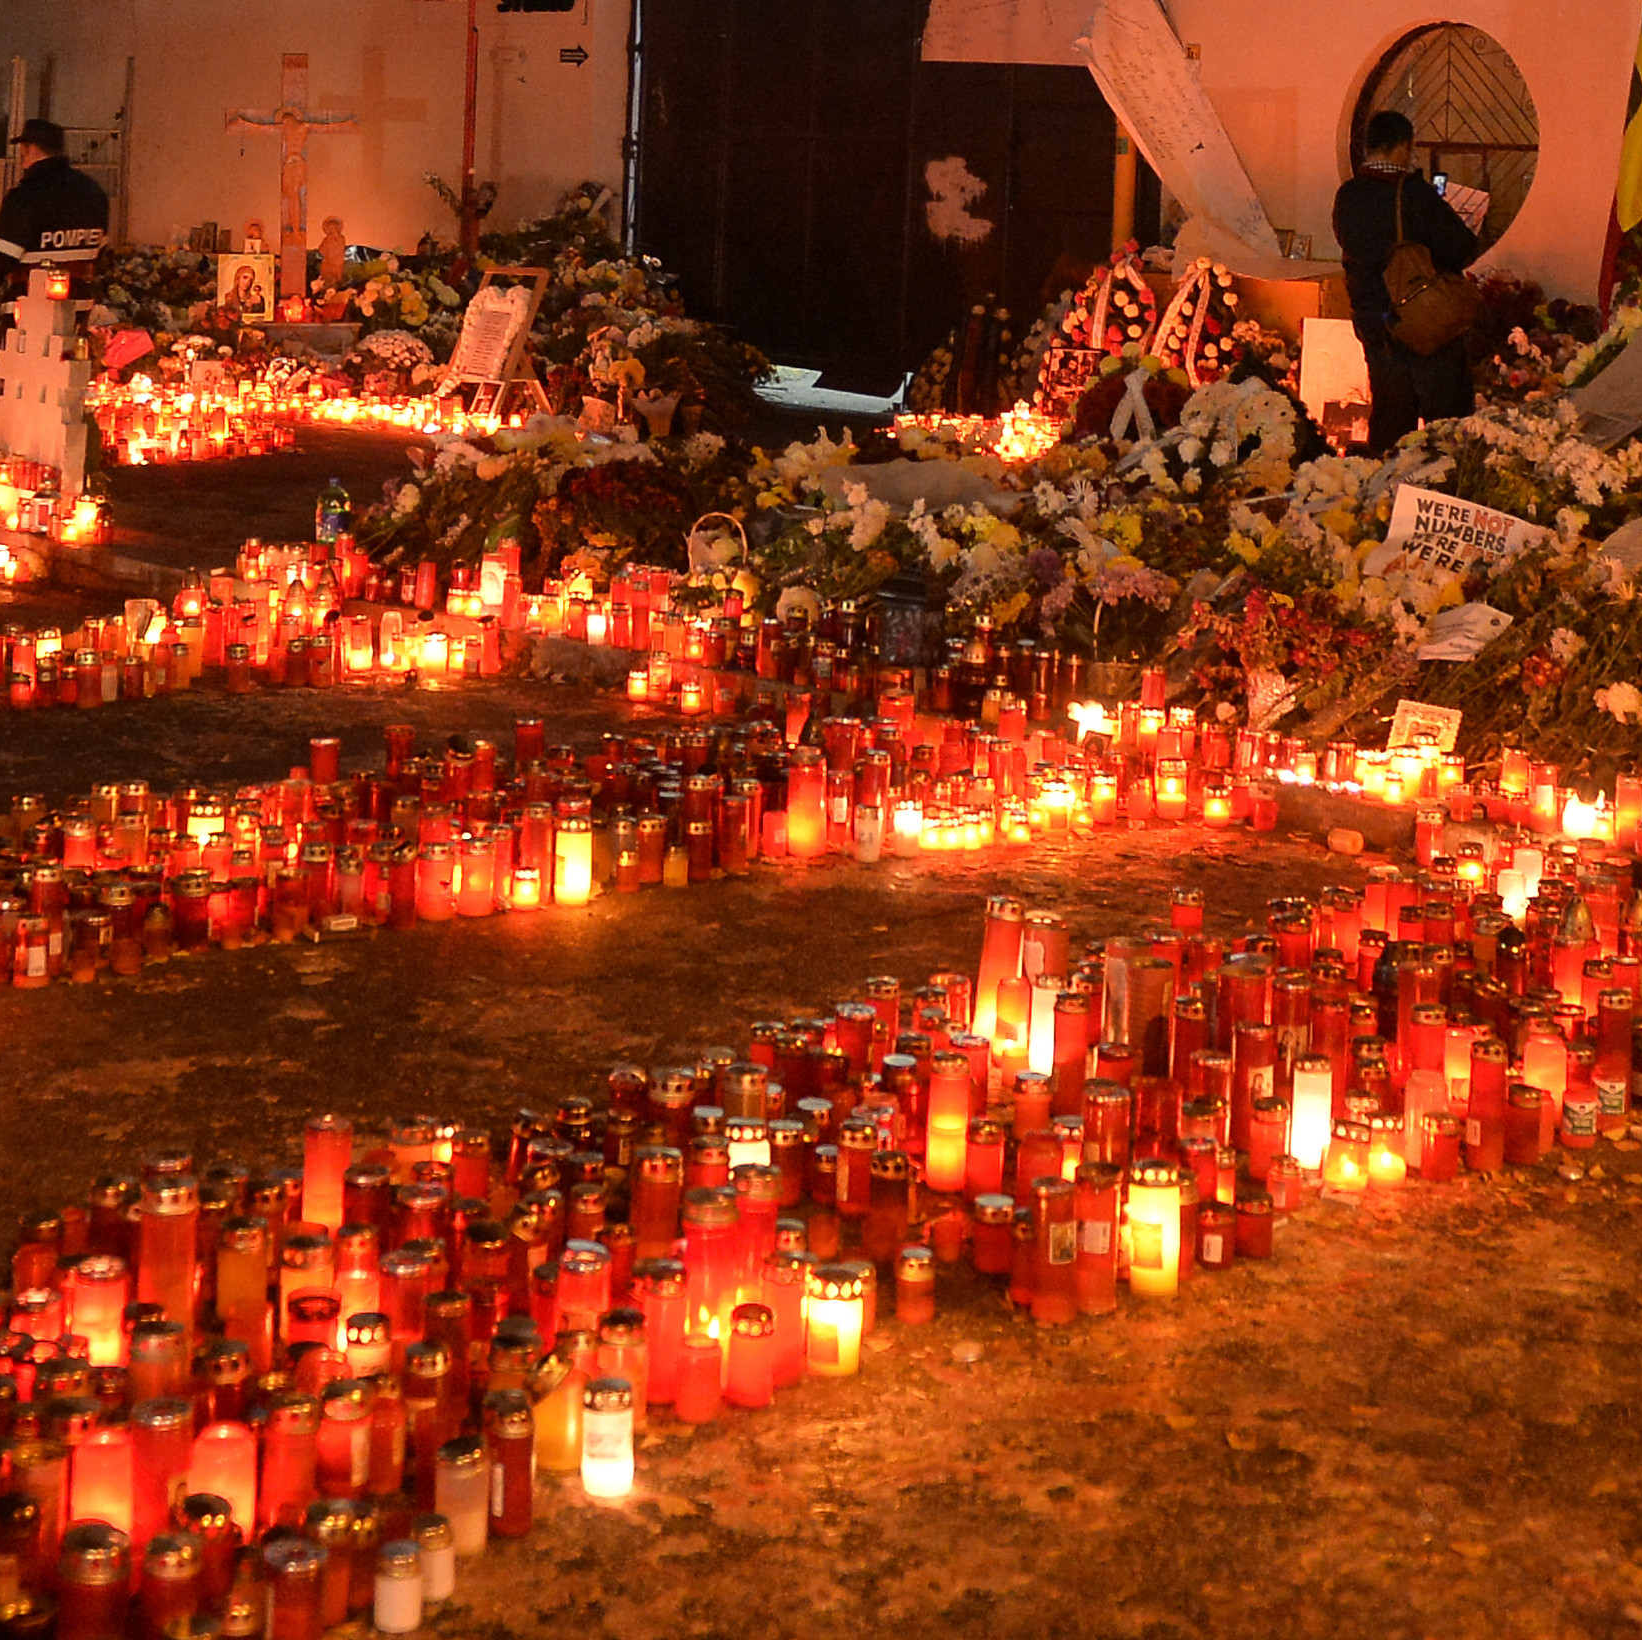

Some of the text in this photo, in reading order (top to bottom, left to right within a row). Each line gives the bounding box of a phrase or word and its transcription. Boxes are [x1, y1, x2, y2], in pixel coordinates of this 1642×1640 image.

[1415, 514, 1507, 553] NUMBERS
[1417, 497, 1515, 536] WE'RE NOT
[1402, 541, 1465, 573] WE'RE
[1412, 531, 1459, 555] WE'RE
